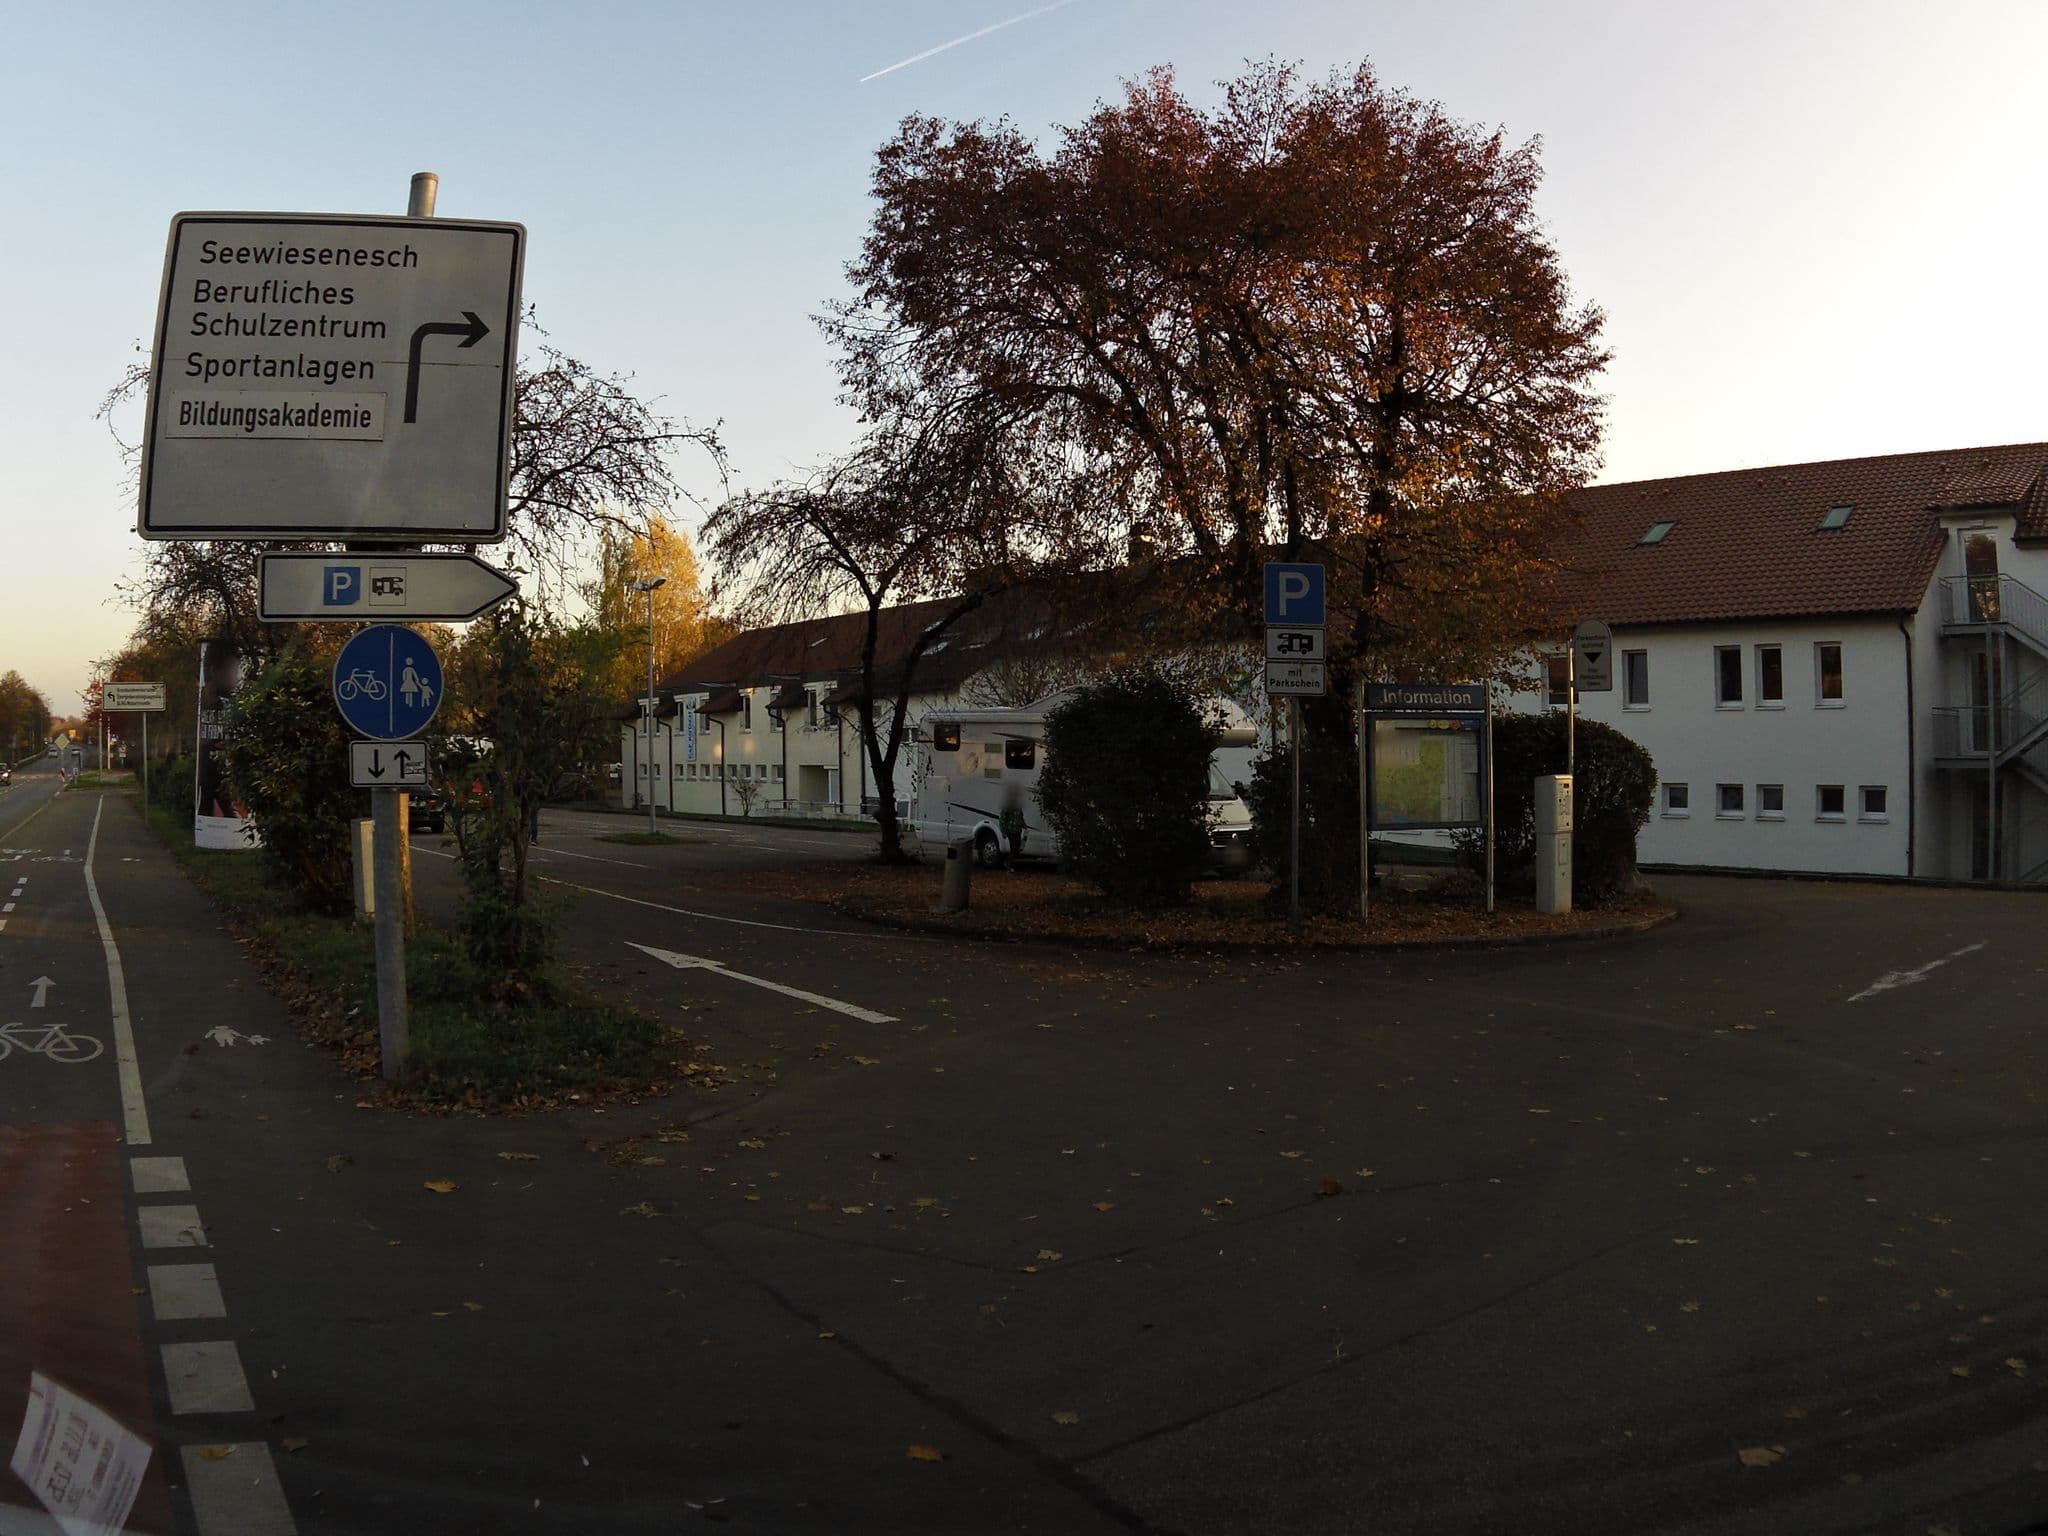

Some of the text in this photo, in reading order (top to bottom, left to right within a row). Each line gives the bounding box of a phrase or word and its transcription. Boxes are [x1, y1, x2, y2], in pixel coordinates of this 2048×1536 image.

[199, 240, 419, 269] Seewiesenesch
[193, 279, 355, 306] Berufliches
[190, 311, 387, 340] Schulzentrum
[184, 351, 375, 385] Sportanlagen
[178, 400, 372, 433] Bildungsakademie
[332, 572, 353, 601] P
[1279, 571, 1311, 616] P
[1269, 677, 1321, 689] Parkschein
[1287, 668, 1302, 678] mit
[1382, 688, 1473, 706] Information
